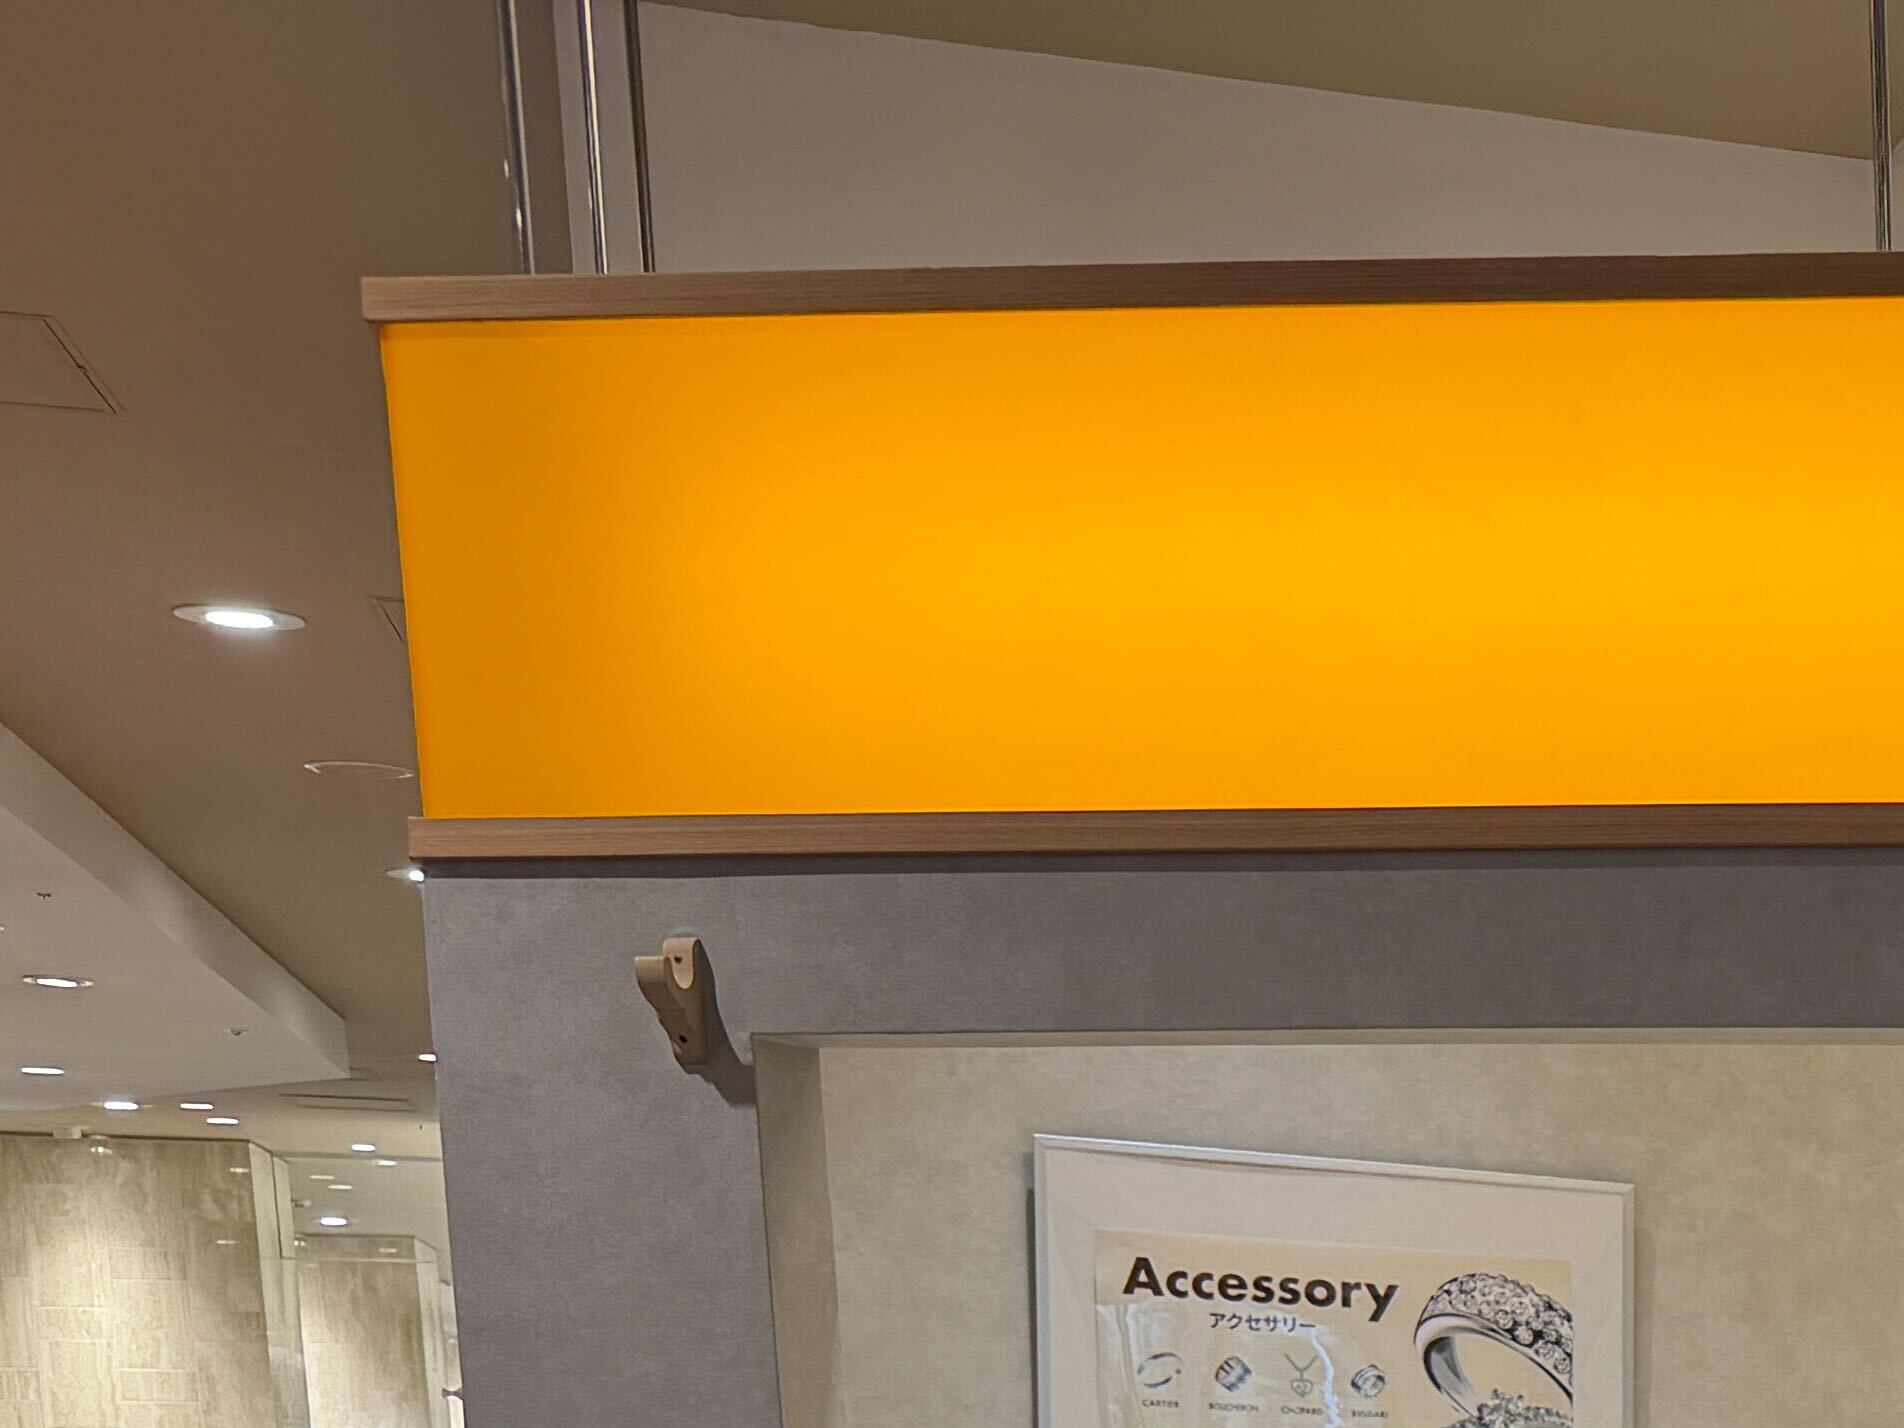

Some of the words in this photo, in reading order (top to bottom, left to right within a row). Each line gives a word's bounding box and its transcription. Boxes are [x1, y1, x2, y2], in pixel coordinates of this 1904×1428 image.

[1123, 1257, 1399, 1322] Accessory
[1208, 1312, 1316, 1332] アクセサリー
